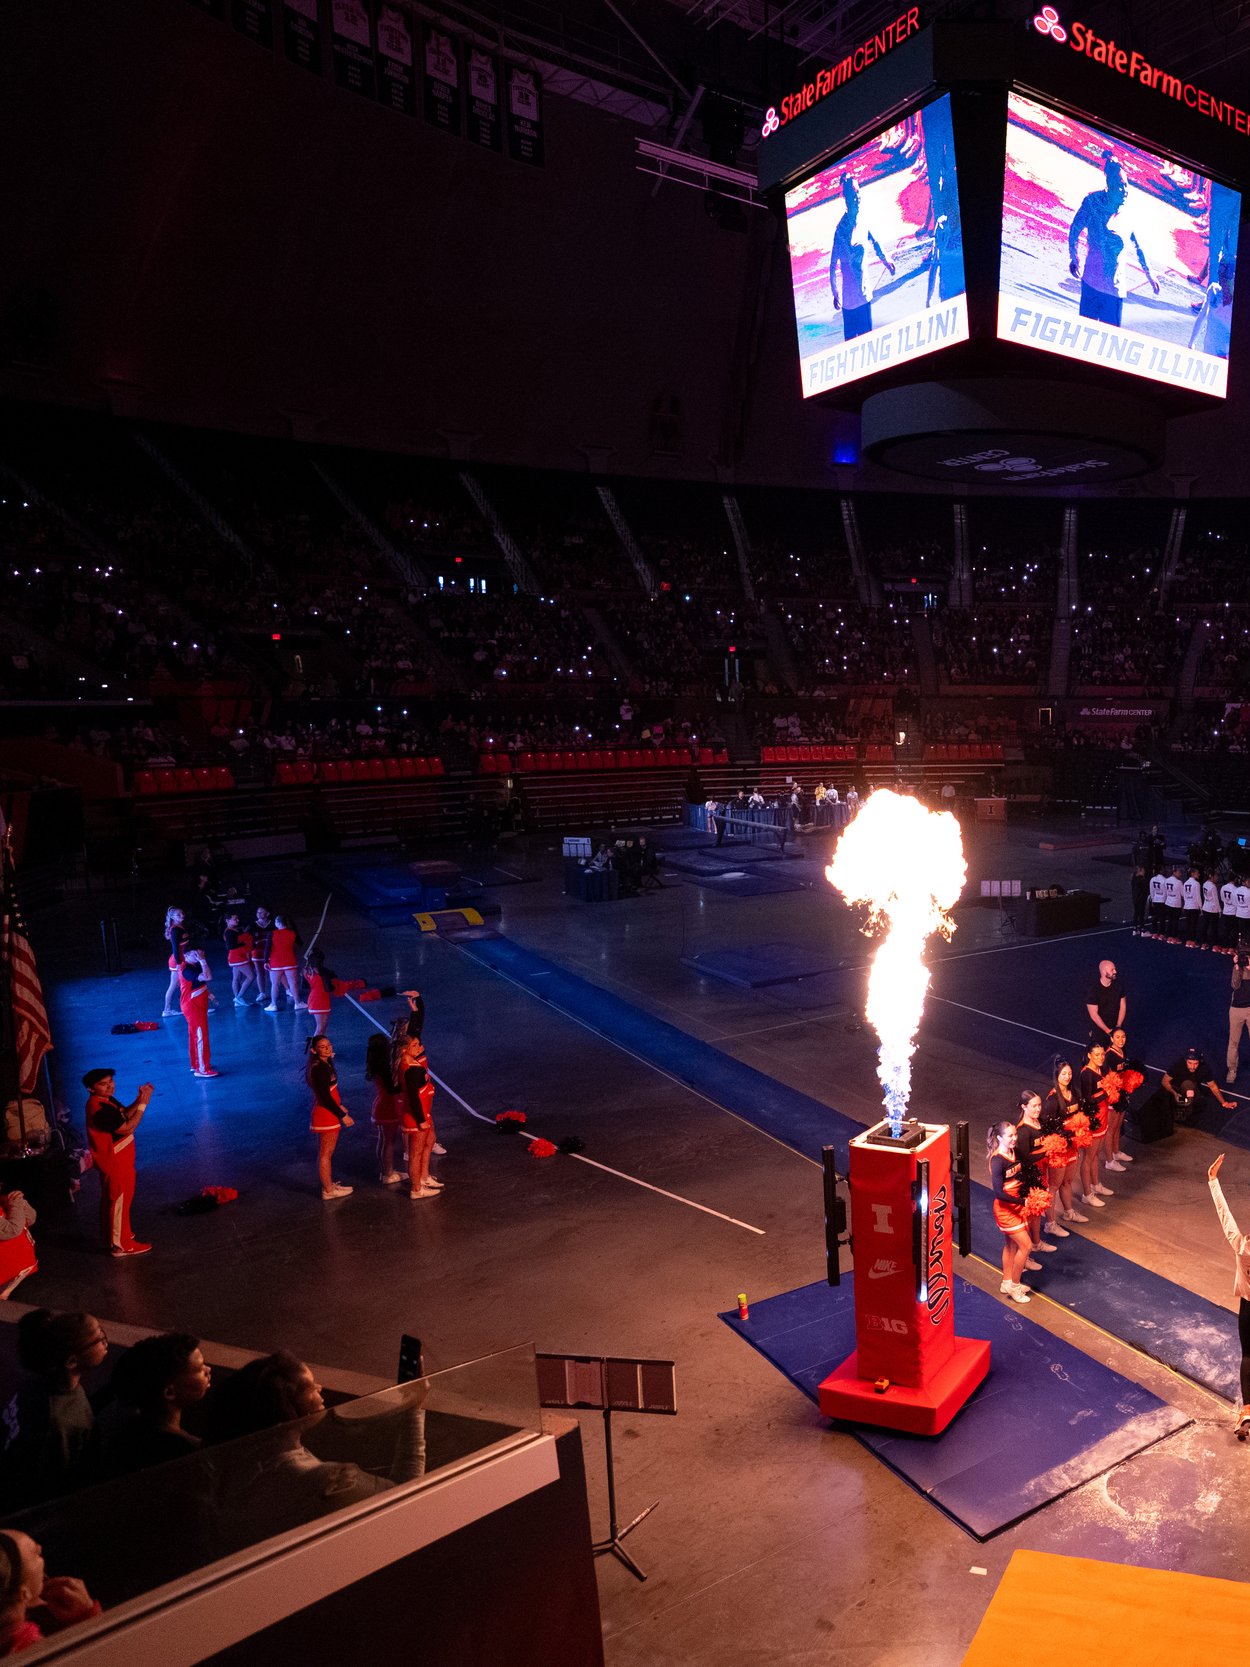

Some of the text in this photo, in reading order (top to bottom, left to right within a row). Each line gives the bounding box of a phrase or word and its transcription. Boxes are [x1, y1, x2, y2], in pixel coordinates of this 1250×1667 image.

[853, 6, 919, 72] CENTER
[809, 306, 958, 389] FIGHTING ILLINI
[1010, 306, 1220, 387] FIGHTING ILLINI
[871, 1203, 894, 1235] I
[874, 1258, 898, 1271] NIKE
